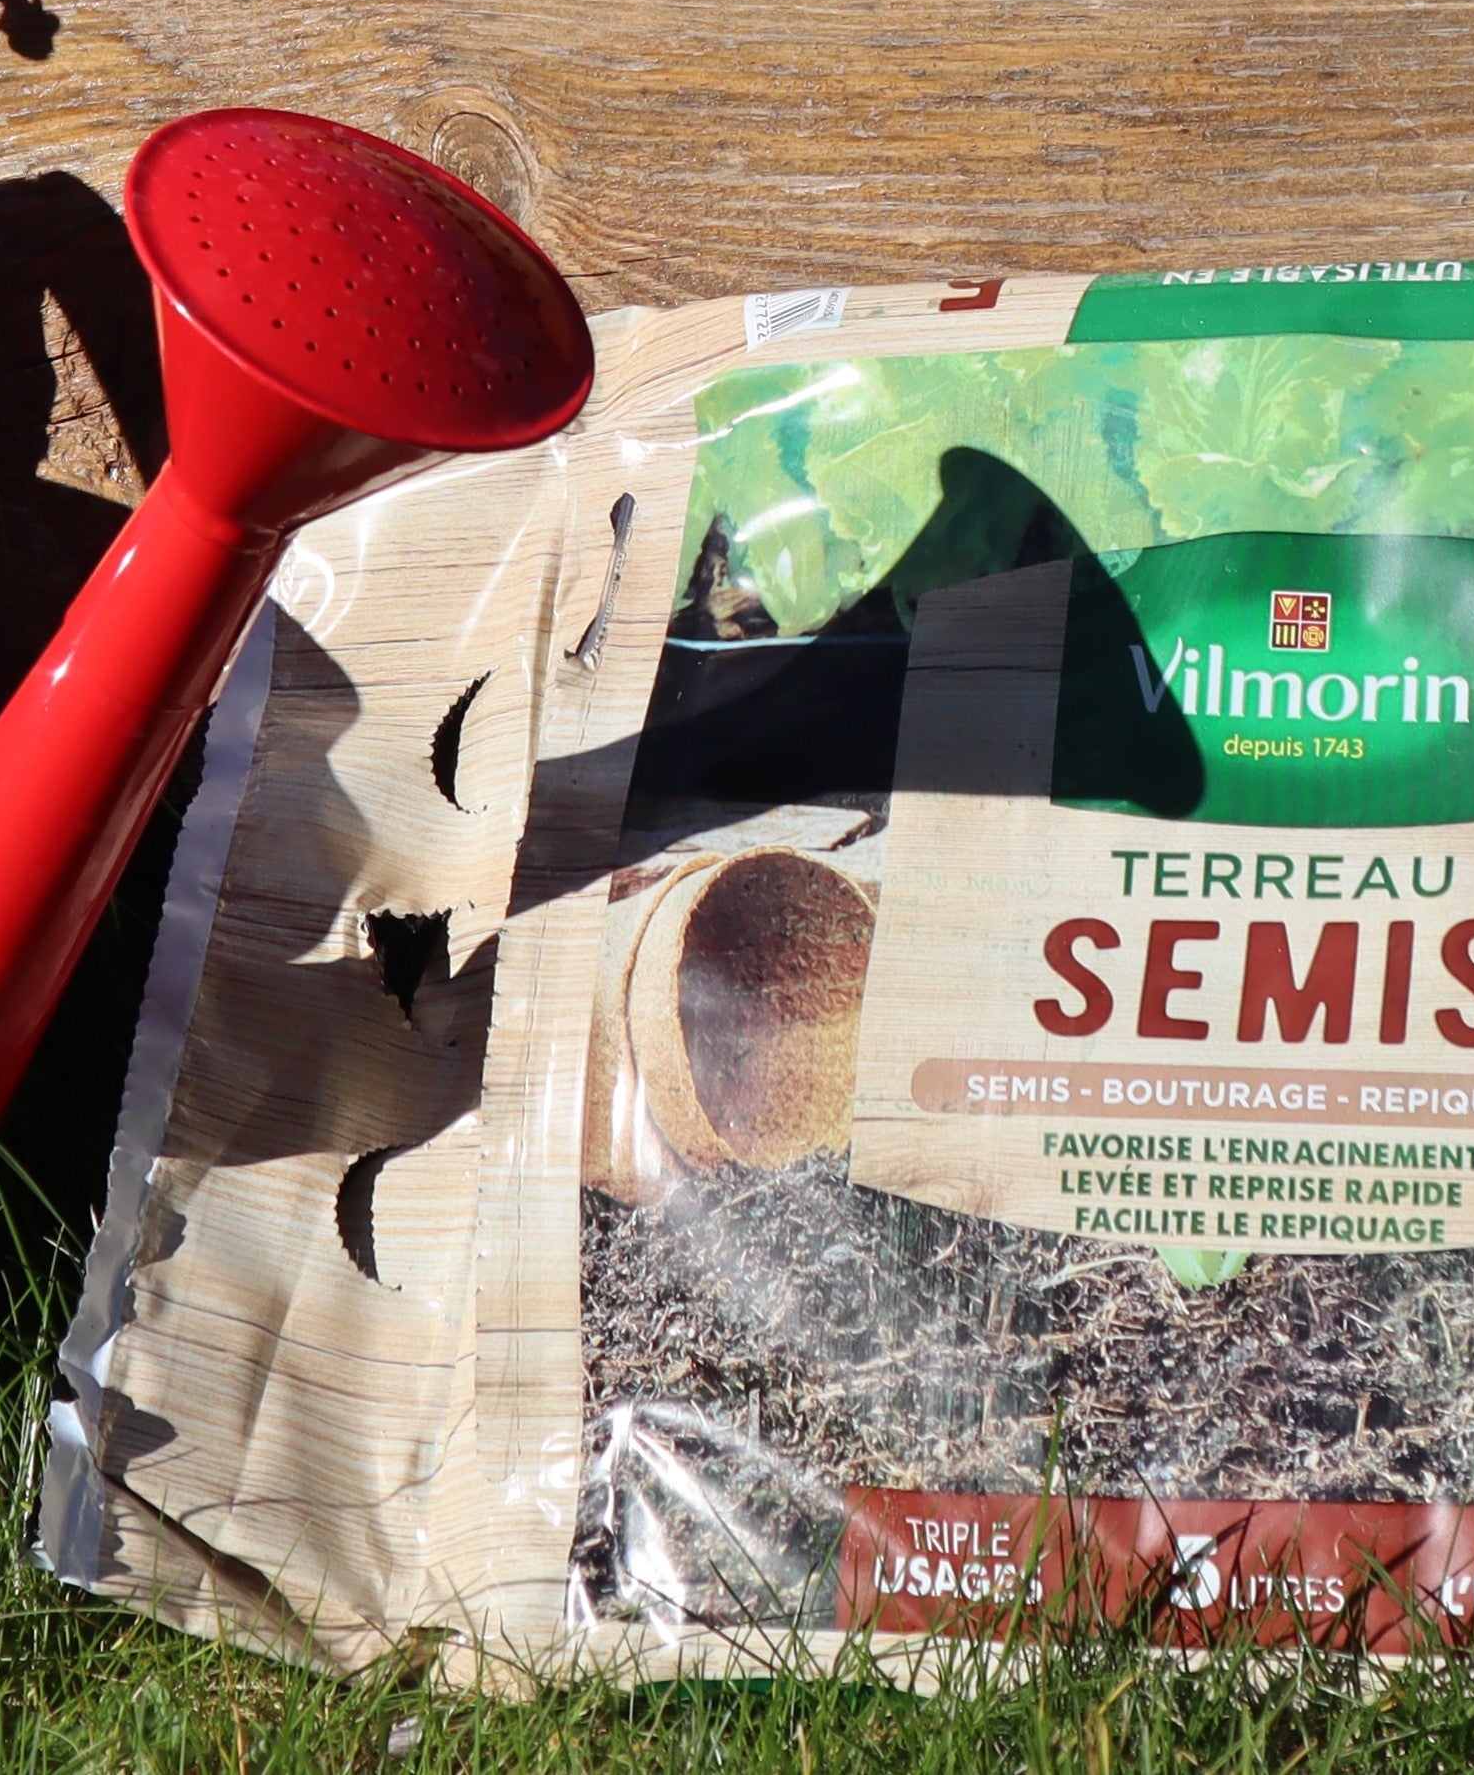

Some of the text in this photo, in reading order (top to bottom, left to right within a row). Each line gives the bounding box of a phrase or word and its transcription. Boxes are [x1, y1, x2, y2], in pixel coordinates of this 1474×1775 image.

[1128, 636, 1471, 725] Vilmorin
[1223, 734, 1365, 761] depuis 1743
[1112, 850, 1455, 899] TERREAU
[966, 1075, 1070, 1103] SEMIS
[1102, 1078, 1327, 1111] BOUTURAGE
[1043, 1132, 1192, 1161] FAVORISE
[1061, 1163, 1463, 1207] LEVÉE ET REPRISE RAPIDE
[1075, 1206, 1446, 1244] FACILITE LE REPIQUAGE
[905, 1516, 1011, 1557] TRIPLE
